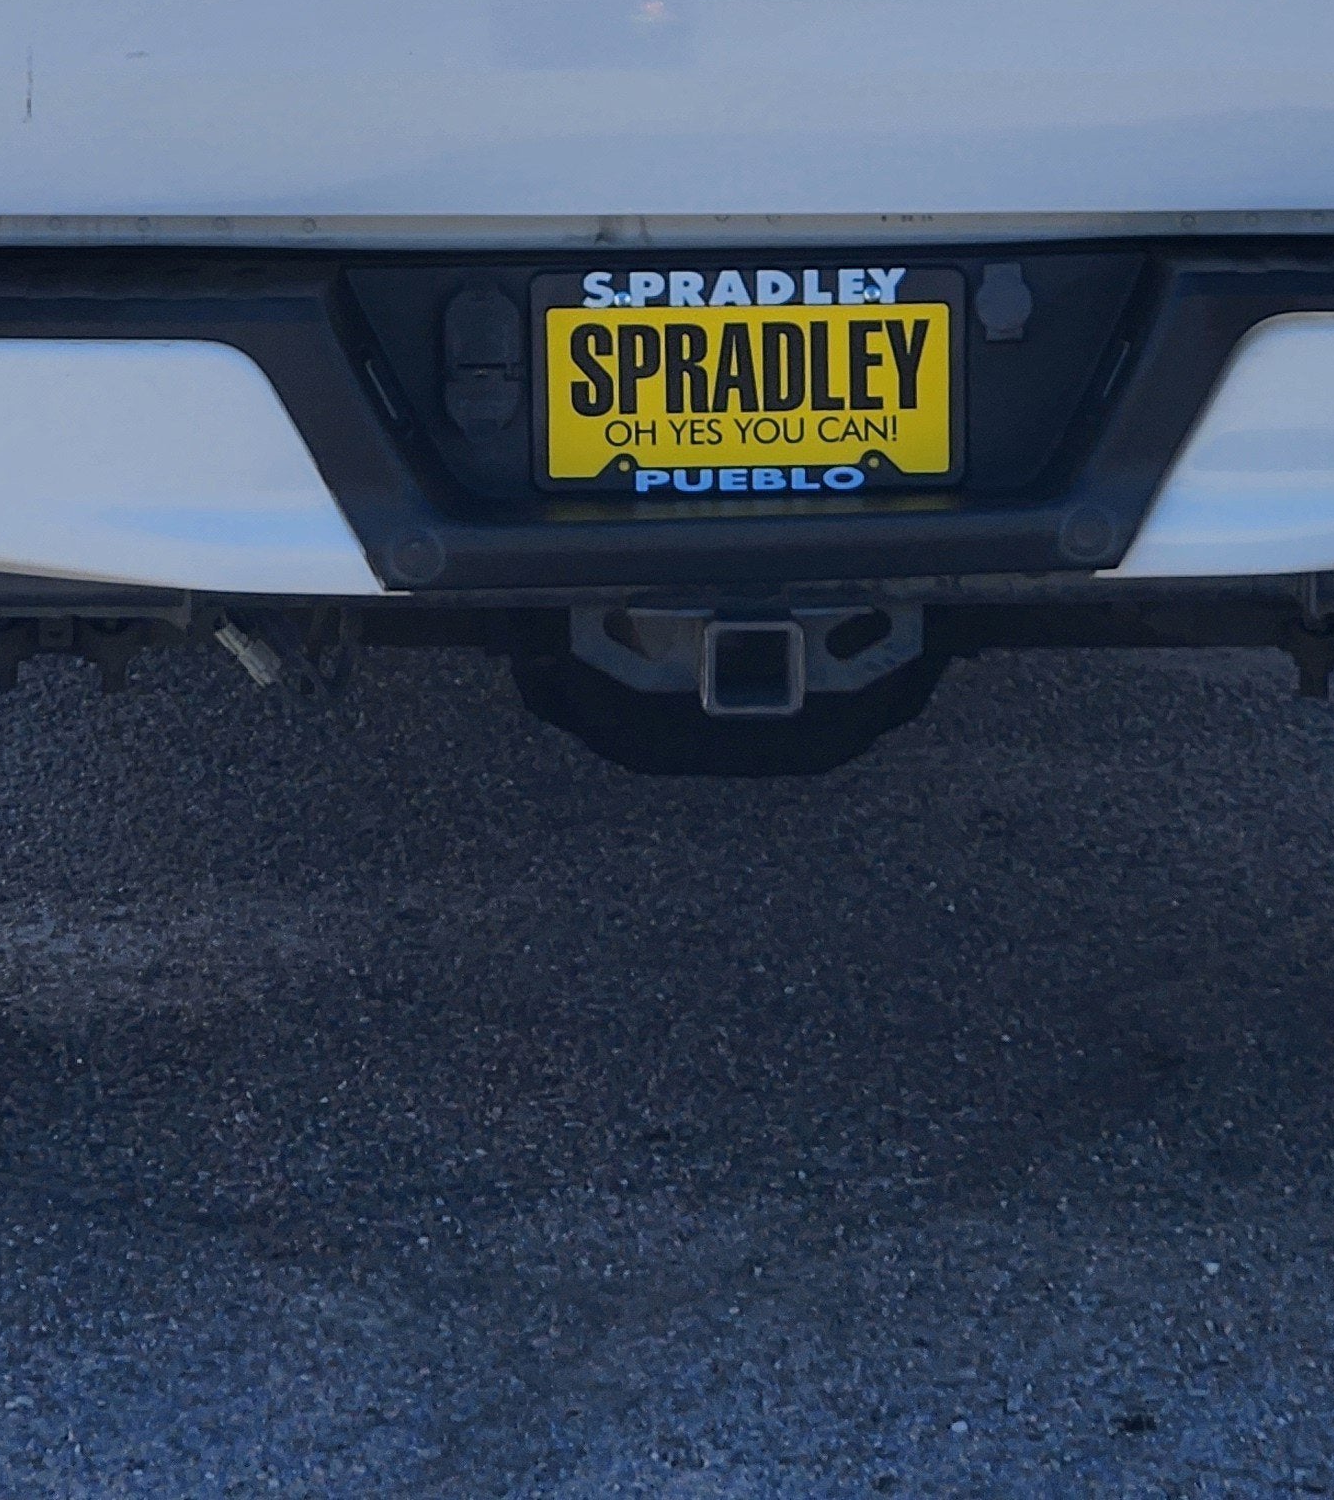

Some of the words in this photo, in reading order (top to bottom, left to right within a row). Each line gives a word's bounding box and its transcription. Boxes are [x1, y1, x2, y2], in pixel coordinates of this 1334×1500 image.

[570, 318, 931, 417] SPRADLEY
[605, 420, 657, 447] OH
[667, 418, 723, 445] YES
[733, 417, 805, 443] YOU
[817, 415, 898, 442] CAN!
[634, 466, 865, 492] PUEBLO
